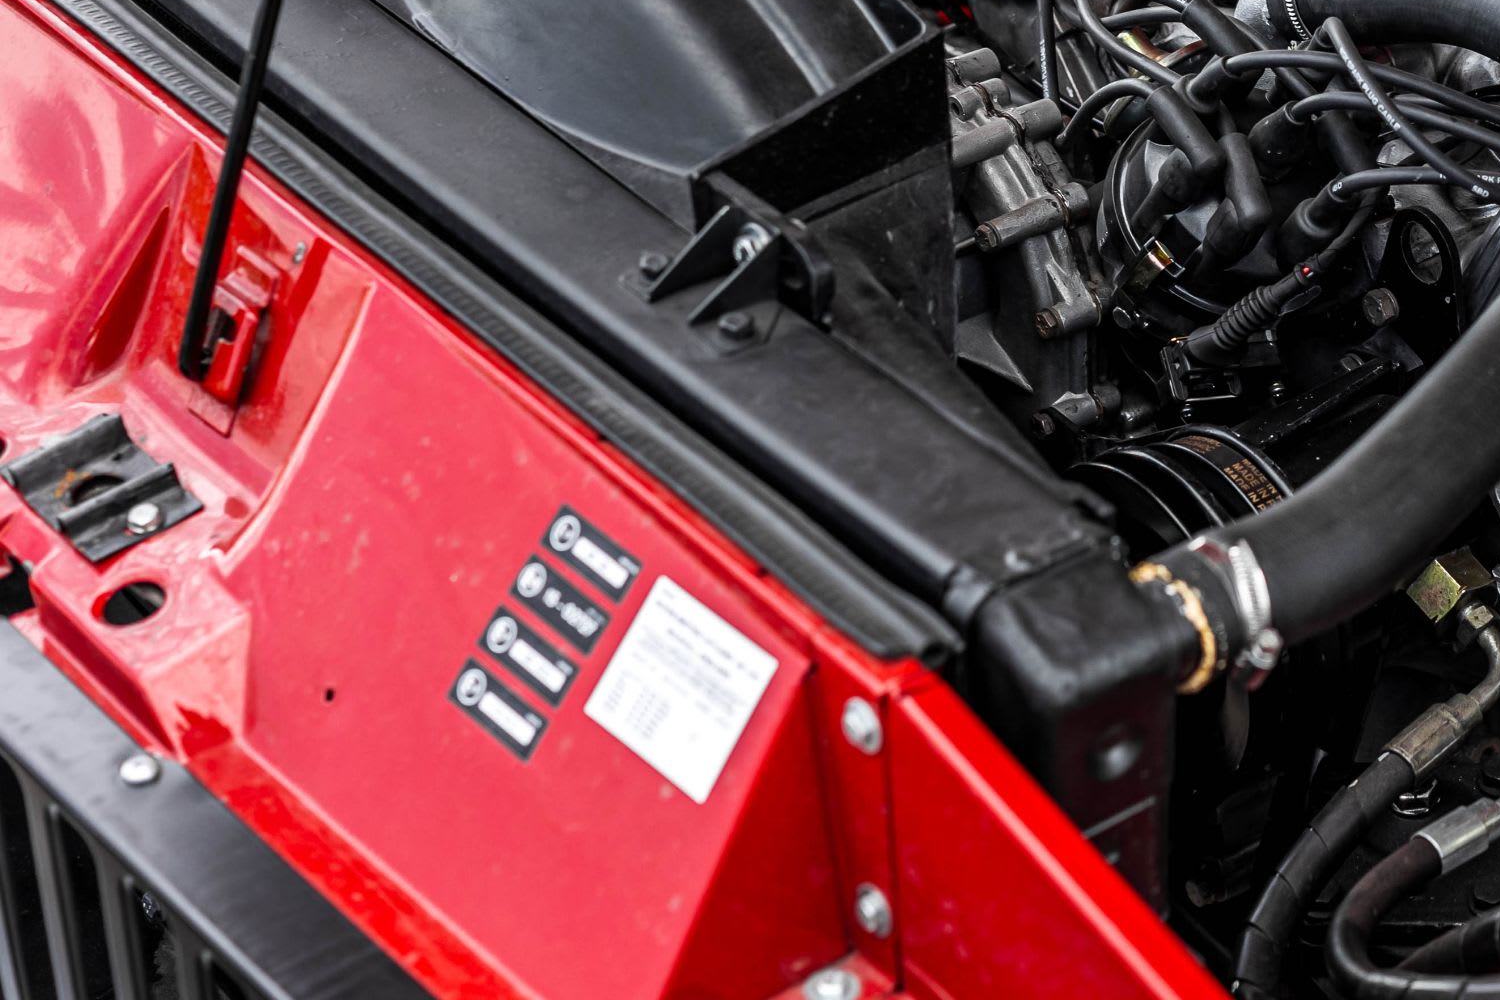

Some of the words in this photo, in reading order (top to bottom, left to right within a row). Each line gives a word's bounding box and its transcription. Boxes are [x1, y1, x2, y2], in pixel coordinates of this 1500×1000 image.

[1361, 82, 1378, 105] PLUG
[1377, 104, 1401, 131] CABLE
[1223, 467, 1251, 491] MADE
[1247, 491, 1261, 504] IN
[1231, 462, 1260, 488] MADE
[1257, 486, 1271, 499] IN
